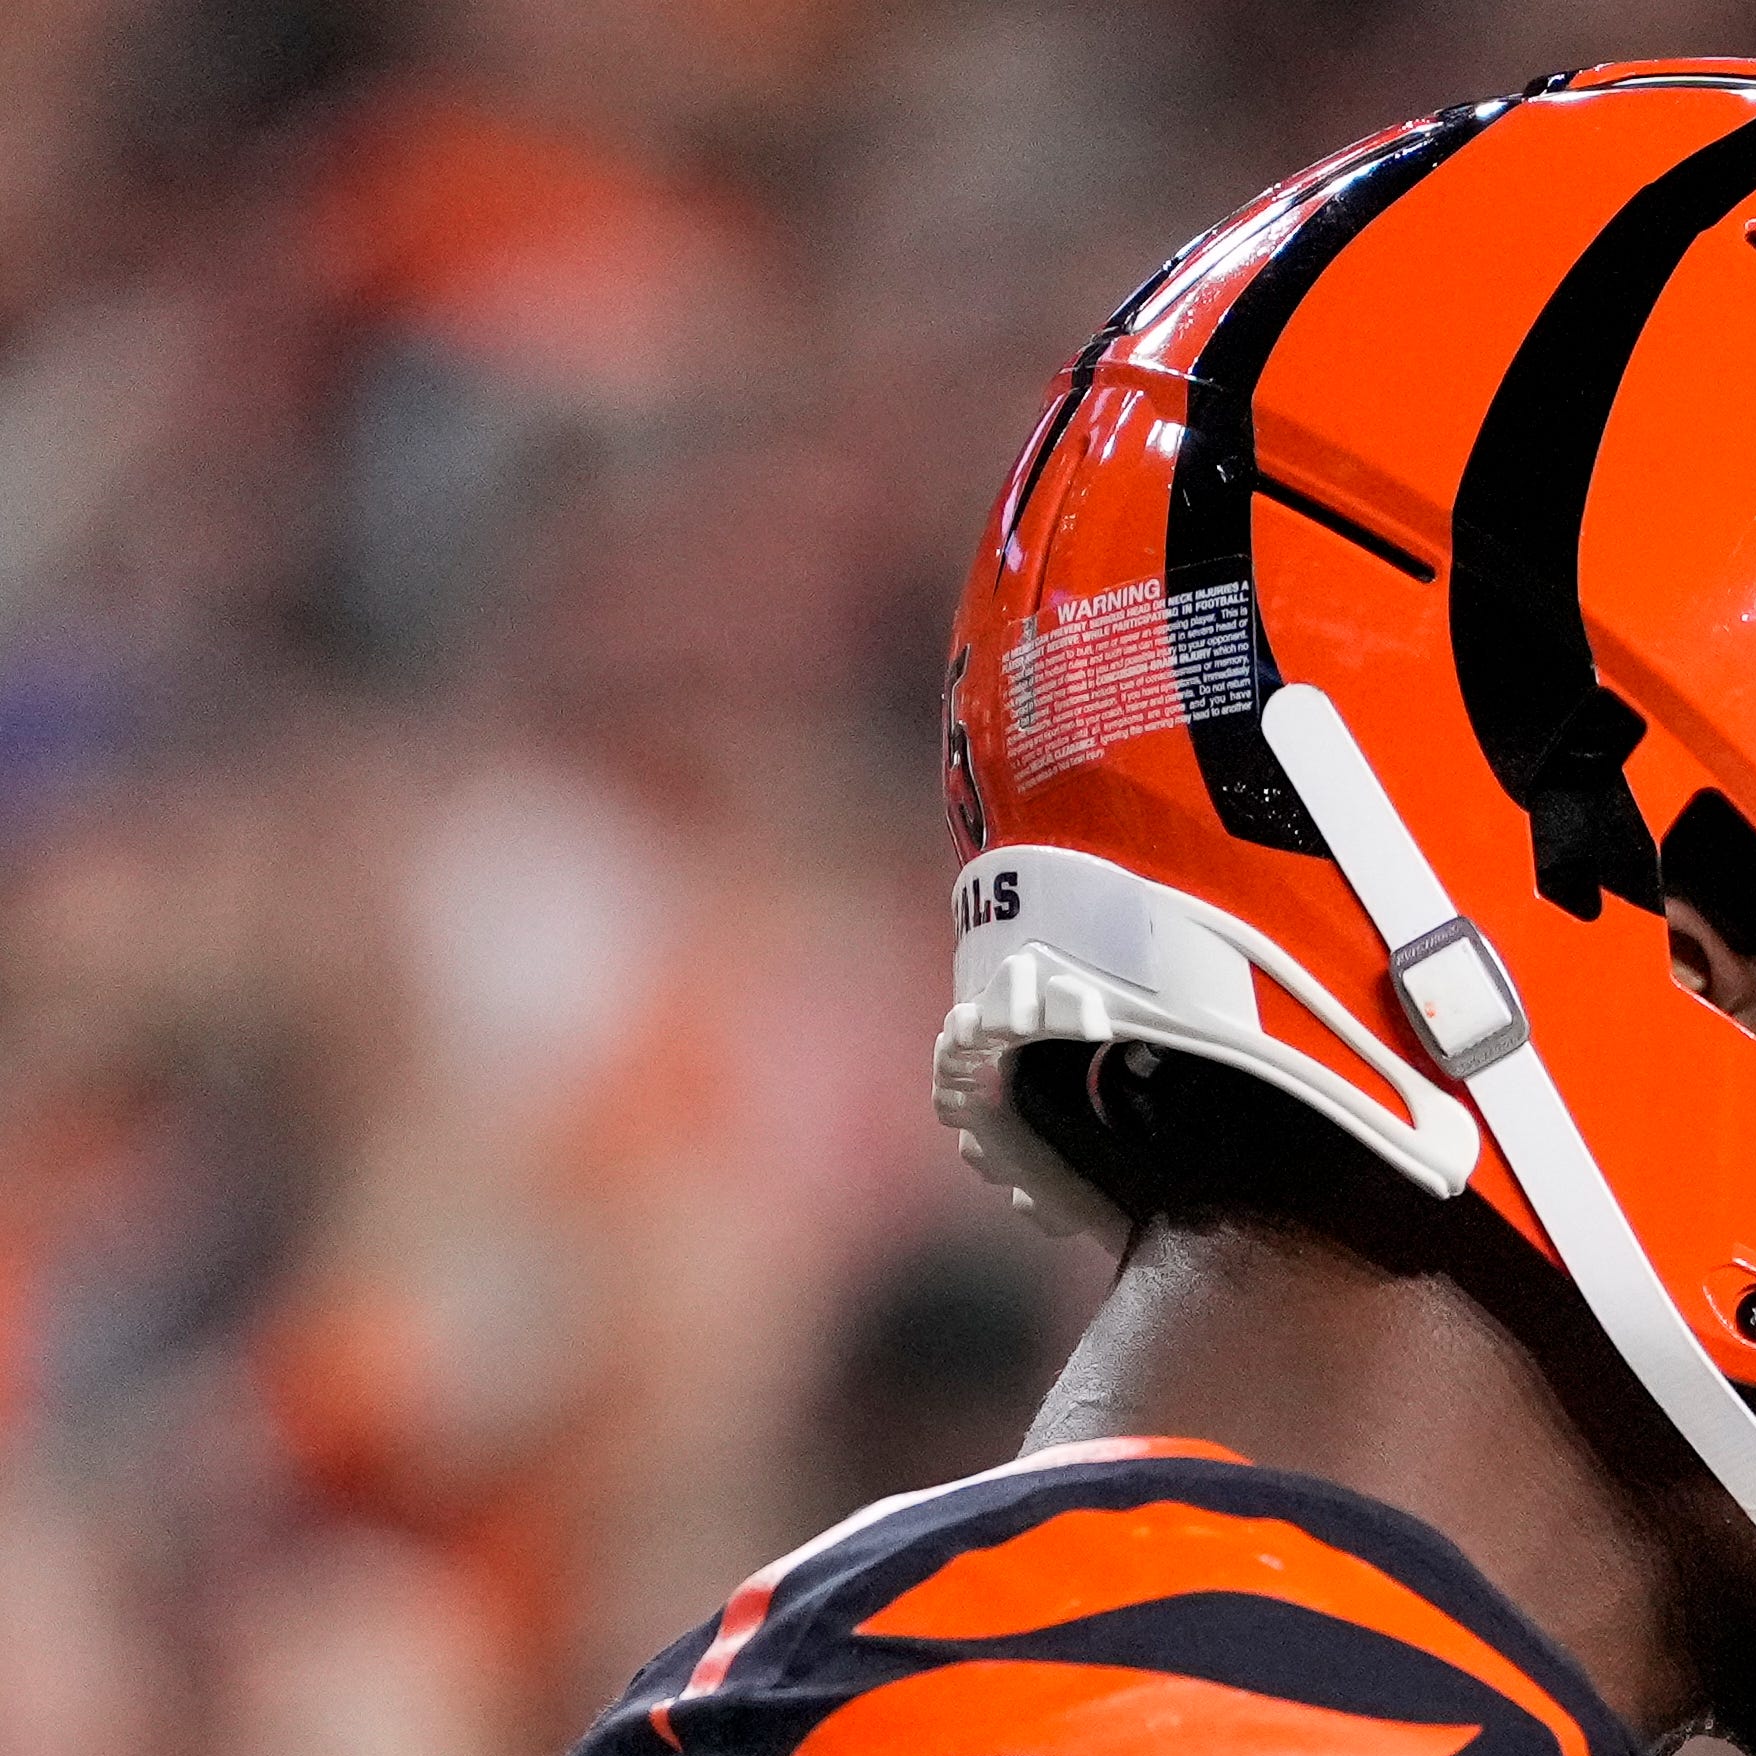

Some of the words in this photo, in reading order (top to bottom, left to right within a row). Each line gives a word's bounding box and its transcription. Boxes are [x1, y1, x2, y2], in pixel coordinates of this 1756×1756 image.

[1057, 579, 1160, 624] WARNING
[1168, 592, 1193, 607] NECK
[1195, 581, 1239, 600] INJURIES
[1241, 580, 1249, 591] A
[1182, 603, 1193, 615] IN
[1195, 592, 1249, 612] FOOTBALL.
[1221, 607, 1238, 619] This
[1188, 640, 1205, 653] your
[1199, 685, 1211, 695] Do
[1212, 682, 1225, 692] not
[1209, 694, 1226, 708] you
[1230, 690, 1251, 700] have
[955, 871, 1020, 944] ALS
